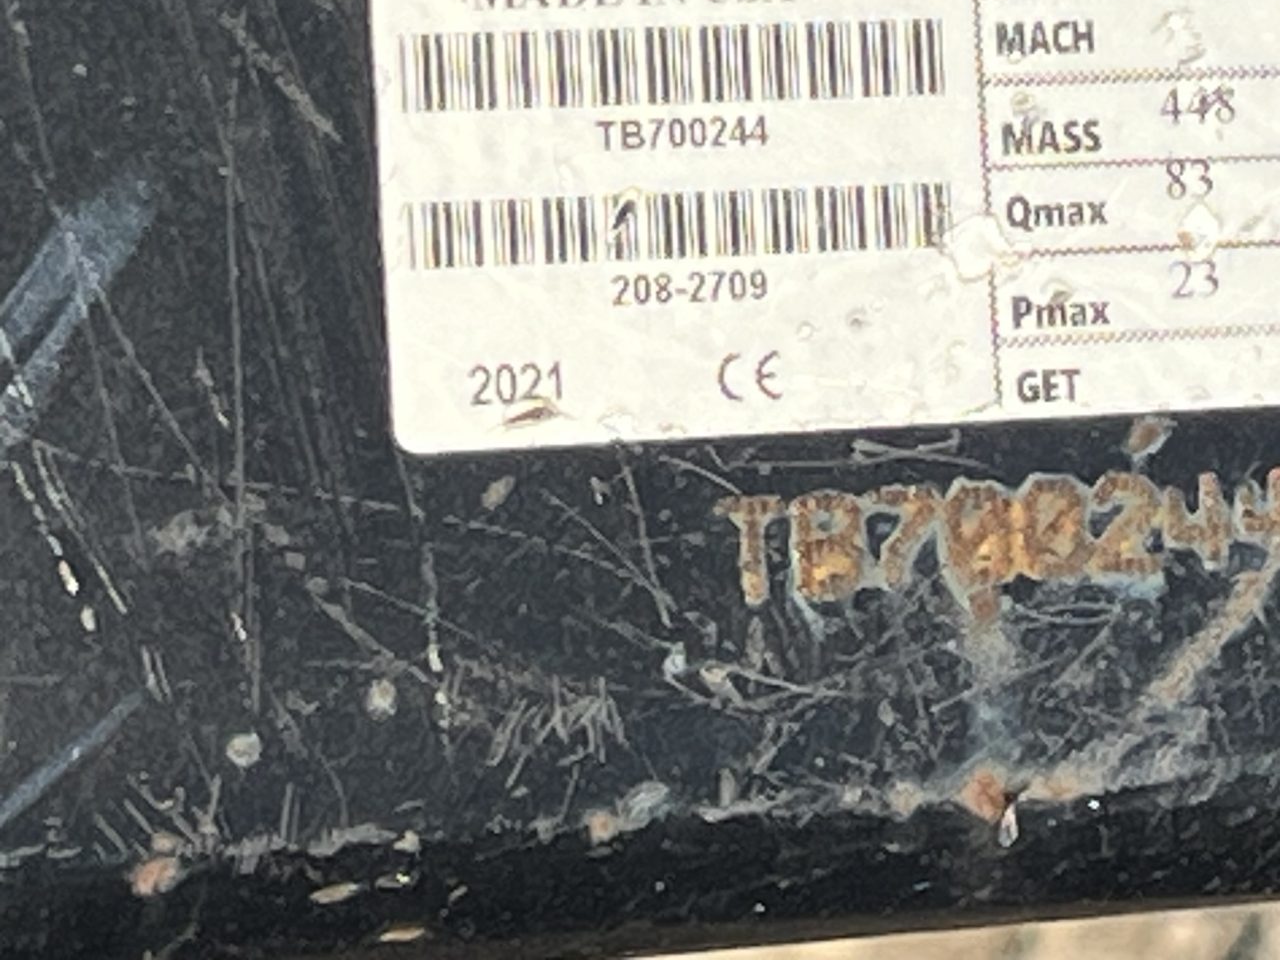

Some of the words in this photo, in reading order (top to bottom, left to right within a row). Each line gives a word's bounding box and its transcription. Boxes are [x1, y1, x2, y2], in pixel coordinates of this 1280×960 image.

[996, 19, 1095, 56] MACH
[596, 115, 769, 151] TB700244
[1001, 119, 1103, 156] MASS
[1166, 157, 1213, 200] 83
[1005, 195, 1107, 232] Qmax
[612, 271, 768, 306] 208-2709
[1170, 259, 1219, 299] 23
[1011, 294, 1111, 330] Pmax
[468, 364, 563, 406] 2021
[1017, 368, 1081, 404] GET
